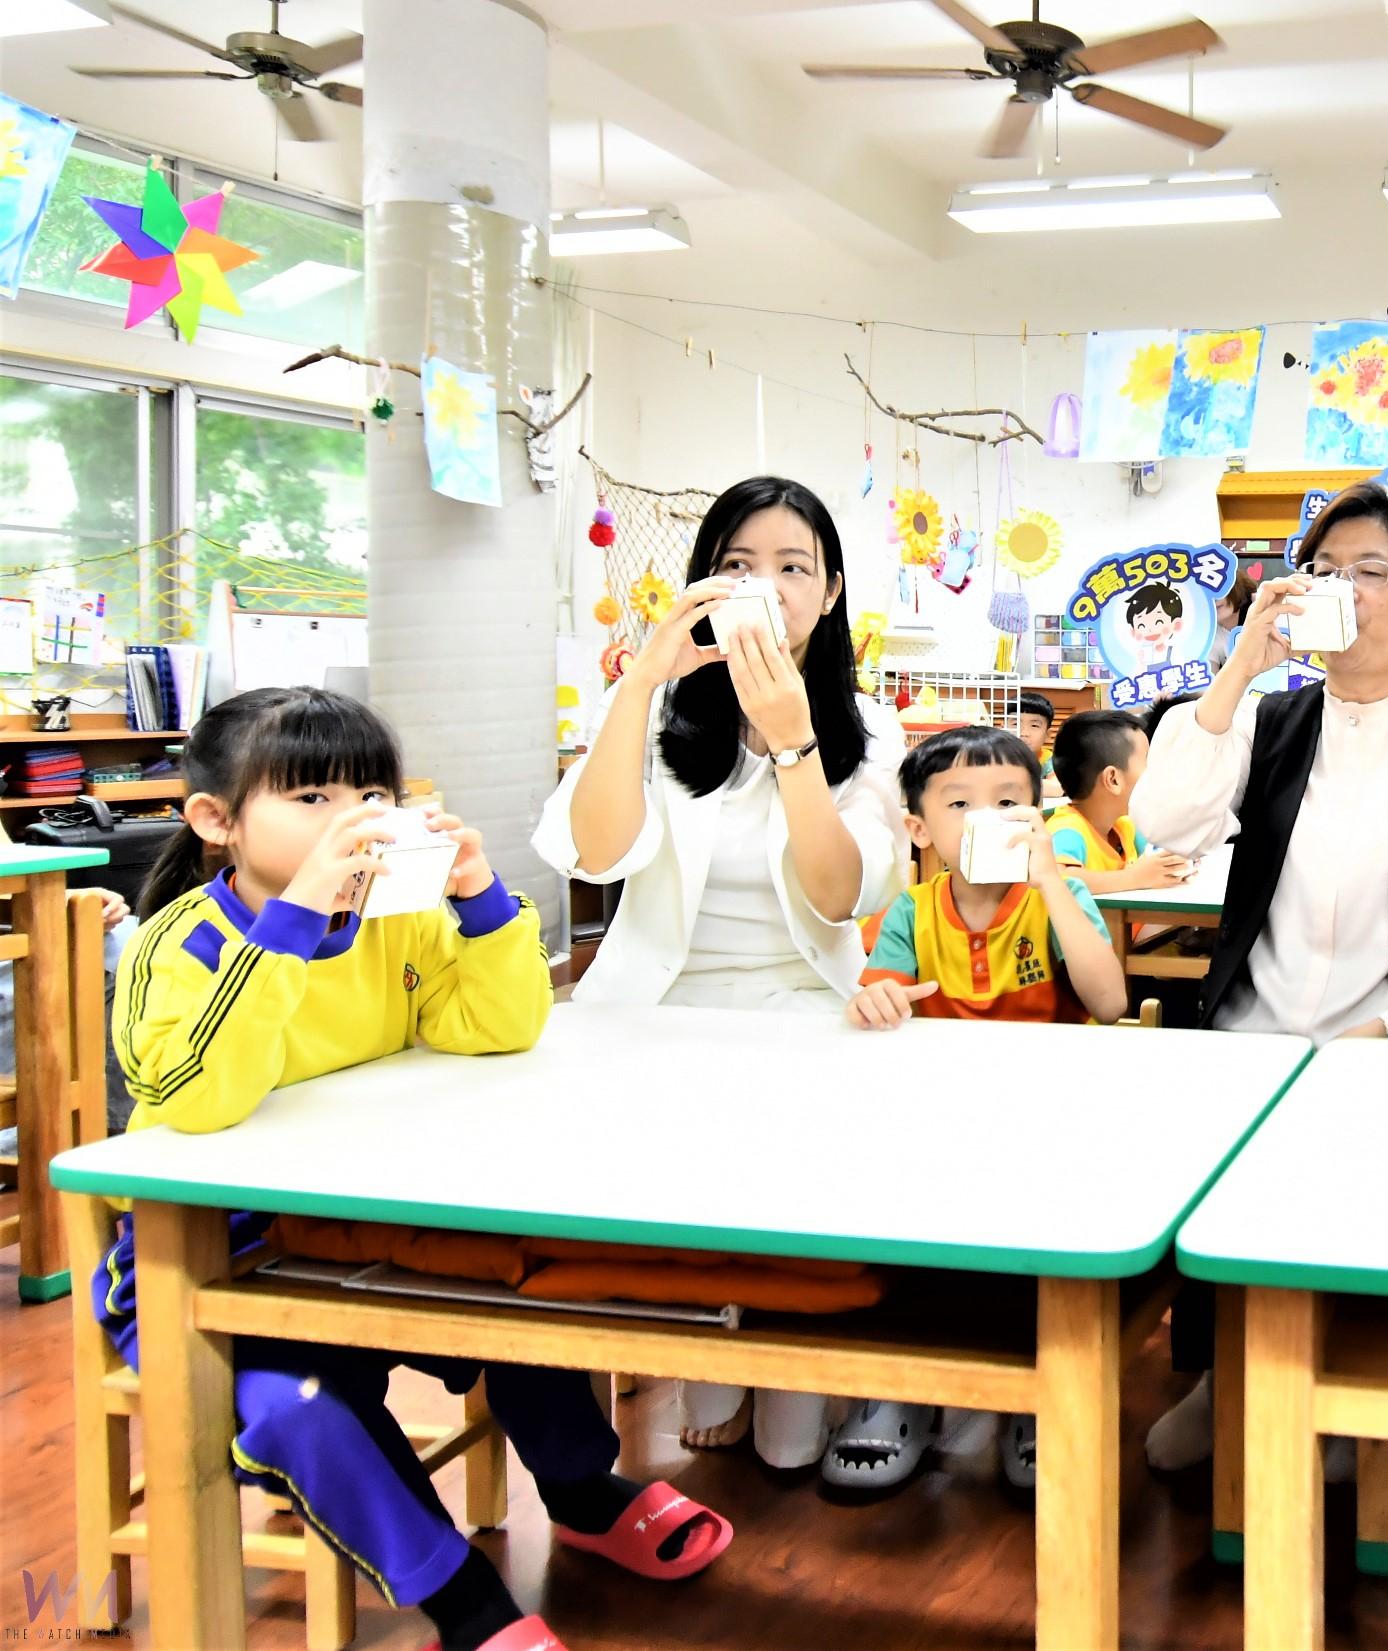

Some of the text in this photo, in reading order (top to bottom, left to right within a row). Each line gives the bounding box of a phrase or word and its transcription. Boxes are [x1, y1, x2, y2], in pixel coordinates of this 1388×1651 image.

[1071, 550, 1228, 620] 9萬503名
[1111, 660, 1211, 707] 受惠學生
